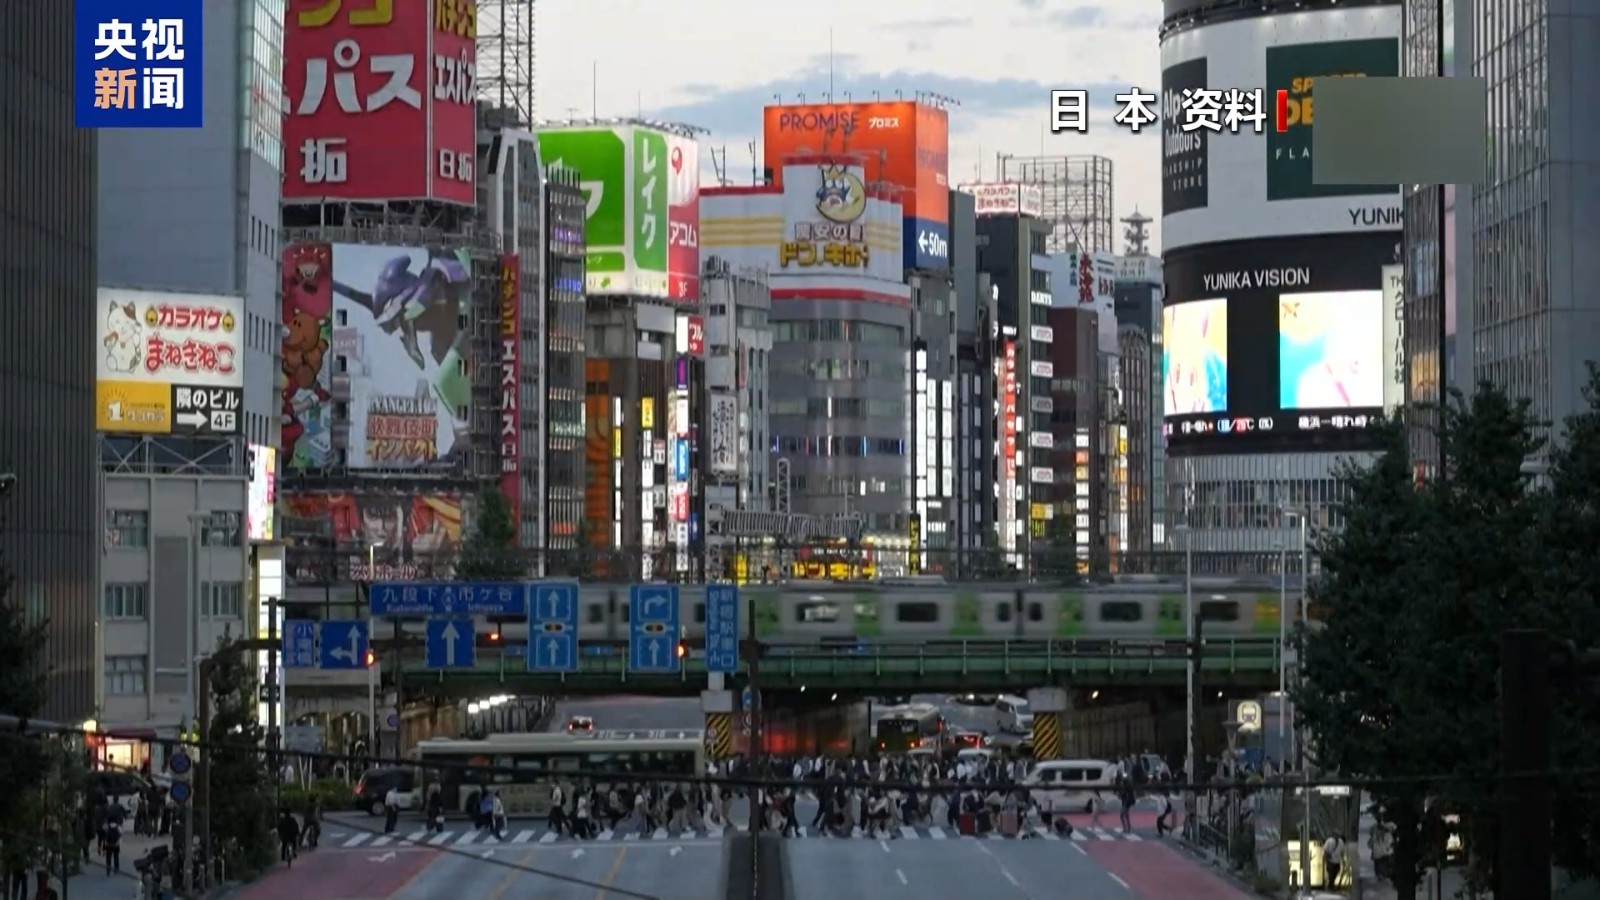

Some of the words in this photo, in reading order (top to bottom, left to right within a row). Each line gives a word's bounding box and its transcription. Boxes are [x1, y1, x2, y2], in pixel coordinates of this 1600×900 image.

[282, 38, 421, 115] パス
[434, 48, 476, 104] エスパス
[1163, 87, 1184, 124] Alp
[779, 112, 860, 131] PROMISE
[440, 149, 472, 182] 日拓
[641, 138, 656, 249] レイク
[669, 221, 697, 247] アコム
[929, 232, 948, 258] 50m
[1203, 271, 1251, 291] YUNIKA
[1254, 267, 1310, 287] VISION
[159, 305, 223, 330] カラオケ
[145, 335, 235, 374] まねきねこ
[213, 414, 233, 428] 4F
